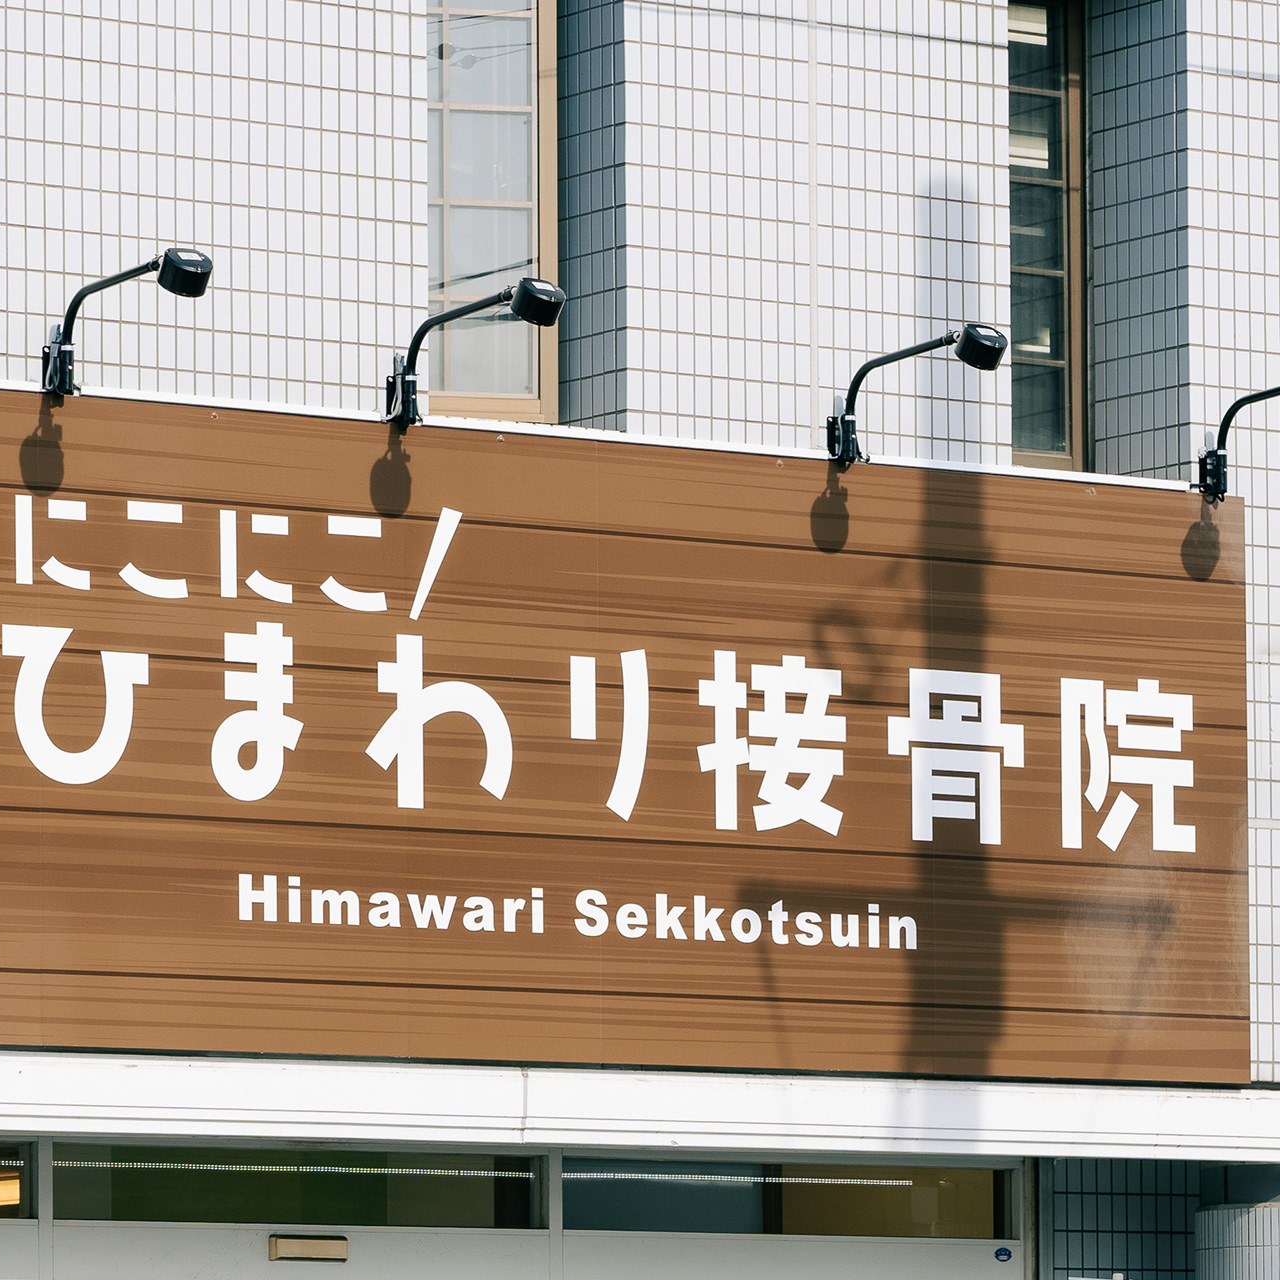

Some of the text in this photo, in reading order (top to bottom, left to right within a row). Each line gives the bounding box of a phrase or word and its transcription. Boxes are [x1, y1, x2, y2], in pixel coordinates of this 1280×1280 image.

[15, 494, 388, 612] にこにこ
[1, 621, 1197, 853] ひまわり接骨院
[237, 873, 919, 951] Himawari Sekkotsuin
